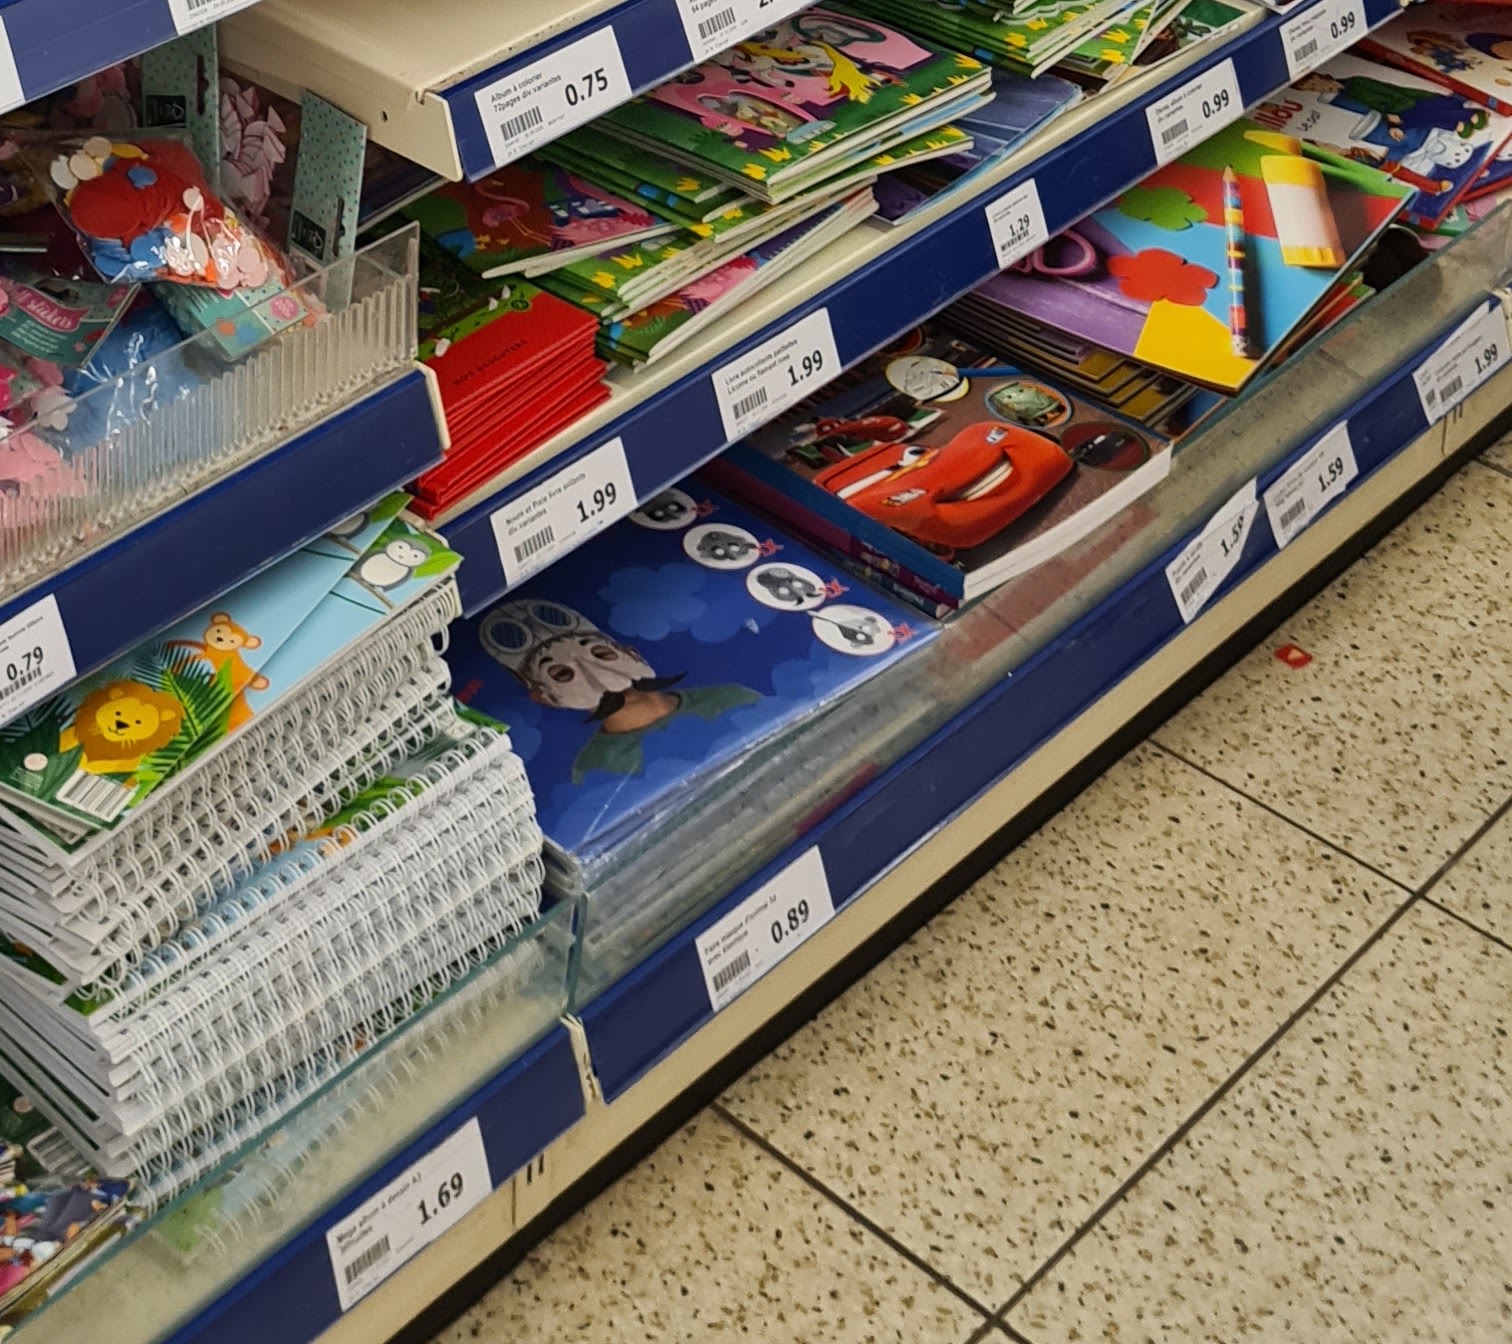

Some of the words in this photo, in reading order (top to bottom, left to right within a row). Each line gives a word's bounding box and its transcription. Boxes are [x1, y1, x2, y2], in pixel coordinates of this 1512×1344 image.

[1330, 11, 1355, 39] 0.99
[565, 67, 608, 106] 0.75
[1202, 89, 1230, 119] 0.99
[1008, 215, 1031, 238] 1.29
[786, 349, 826, 389] 1.99
[1472, 343, 1498, 377] 1.99
[1318, 456, 1345, 493] 1.59
[576, 482, 619, 525] 1.99
[5, 645, 48, 685] 0.79
[767, 899, 808, 945] 0.89
[418, 1172, 464, 1226] 1.69
